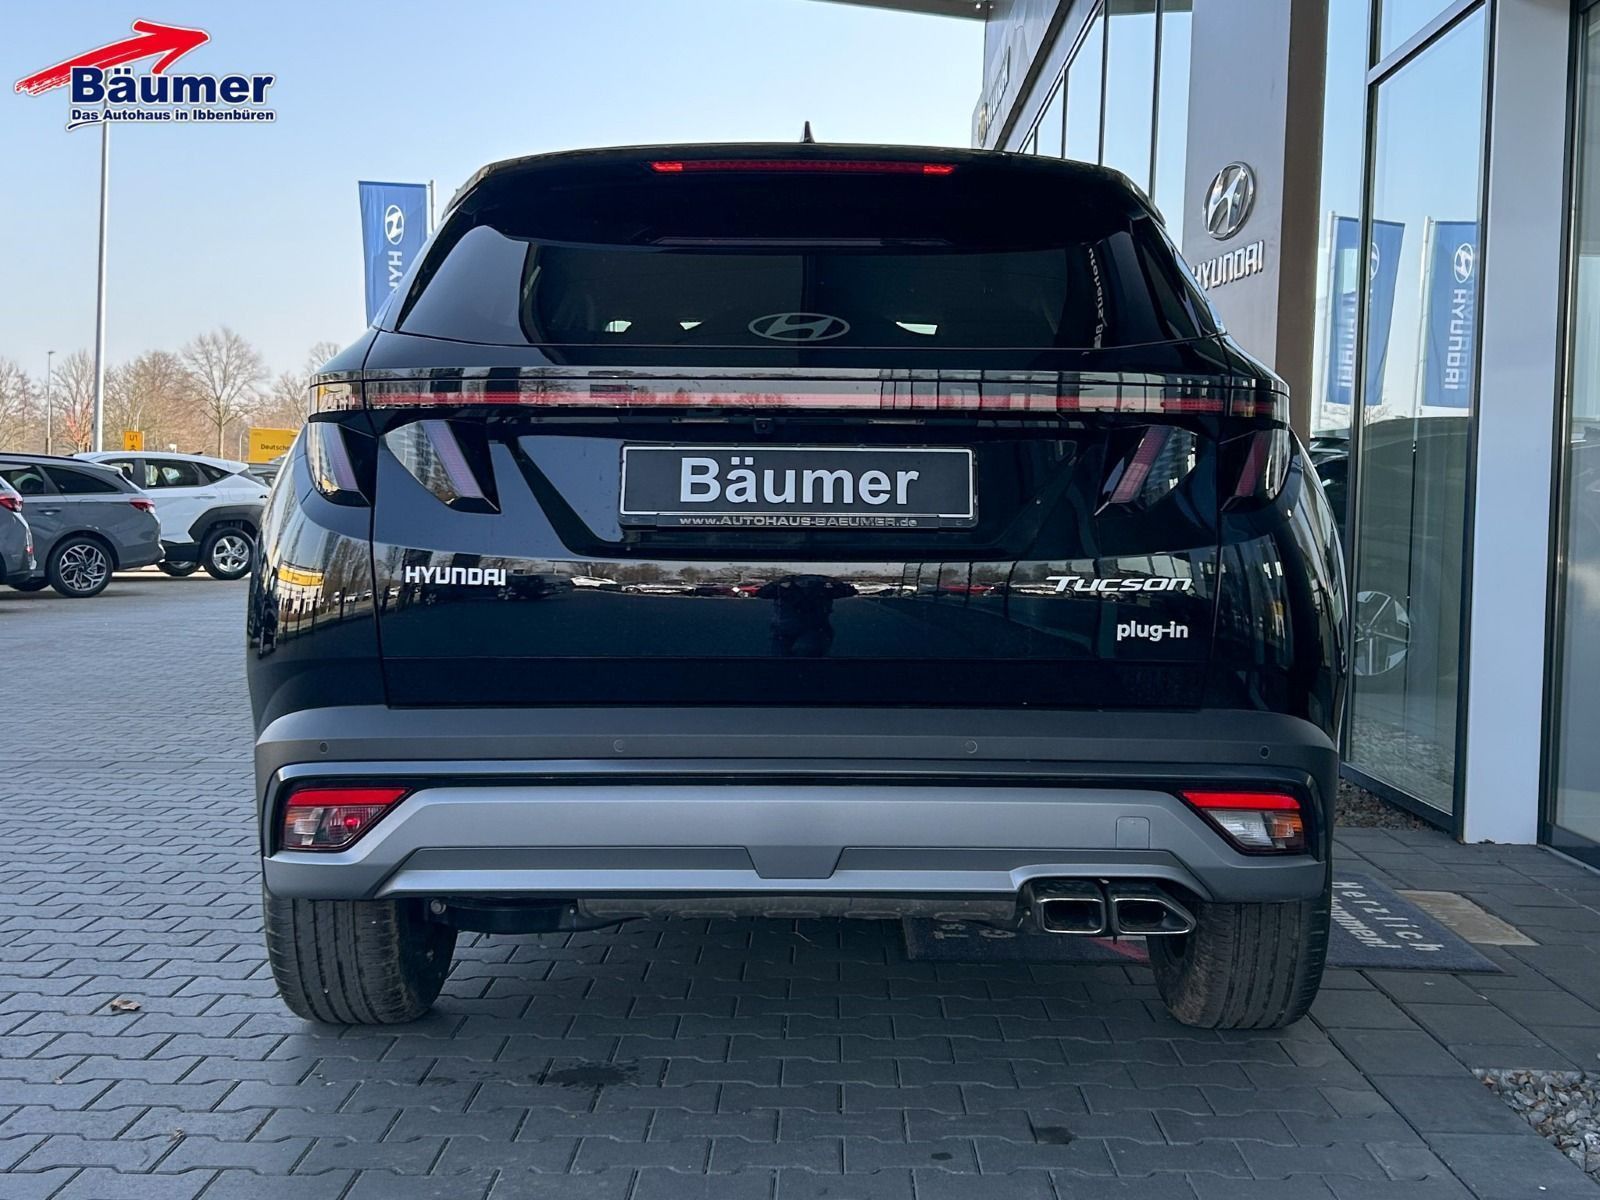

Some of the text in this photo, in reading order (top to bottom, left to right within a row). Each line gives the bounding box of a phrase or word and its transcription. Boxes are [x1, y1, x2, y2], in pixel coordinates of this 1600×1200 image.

[1192, 240, 1264, 291] HYUNDAI
[1444, 289, 1467, 389] HYUNDAI
[680, 456, 919, 504] Bäumer
[679, 515, 917, 527] www.AUTOHAUS-BAEUMER.de
[404, 566, 506, 586] HYUNDAI
[1116, 620, 1188, 641] plug-in
[1332, 881, 1445, 951] Herzlich
